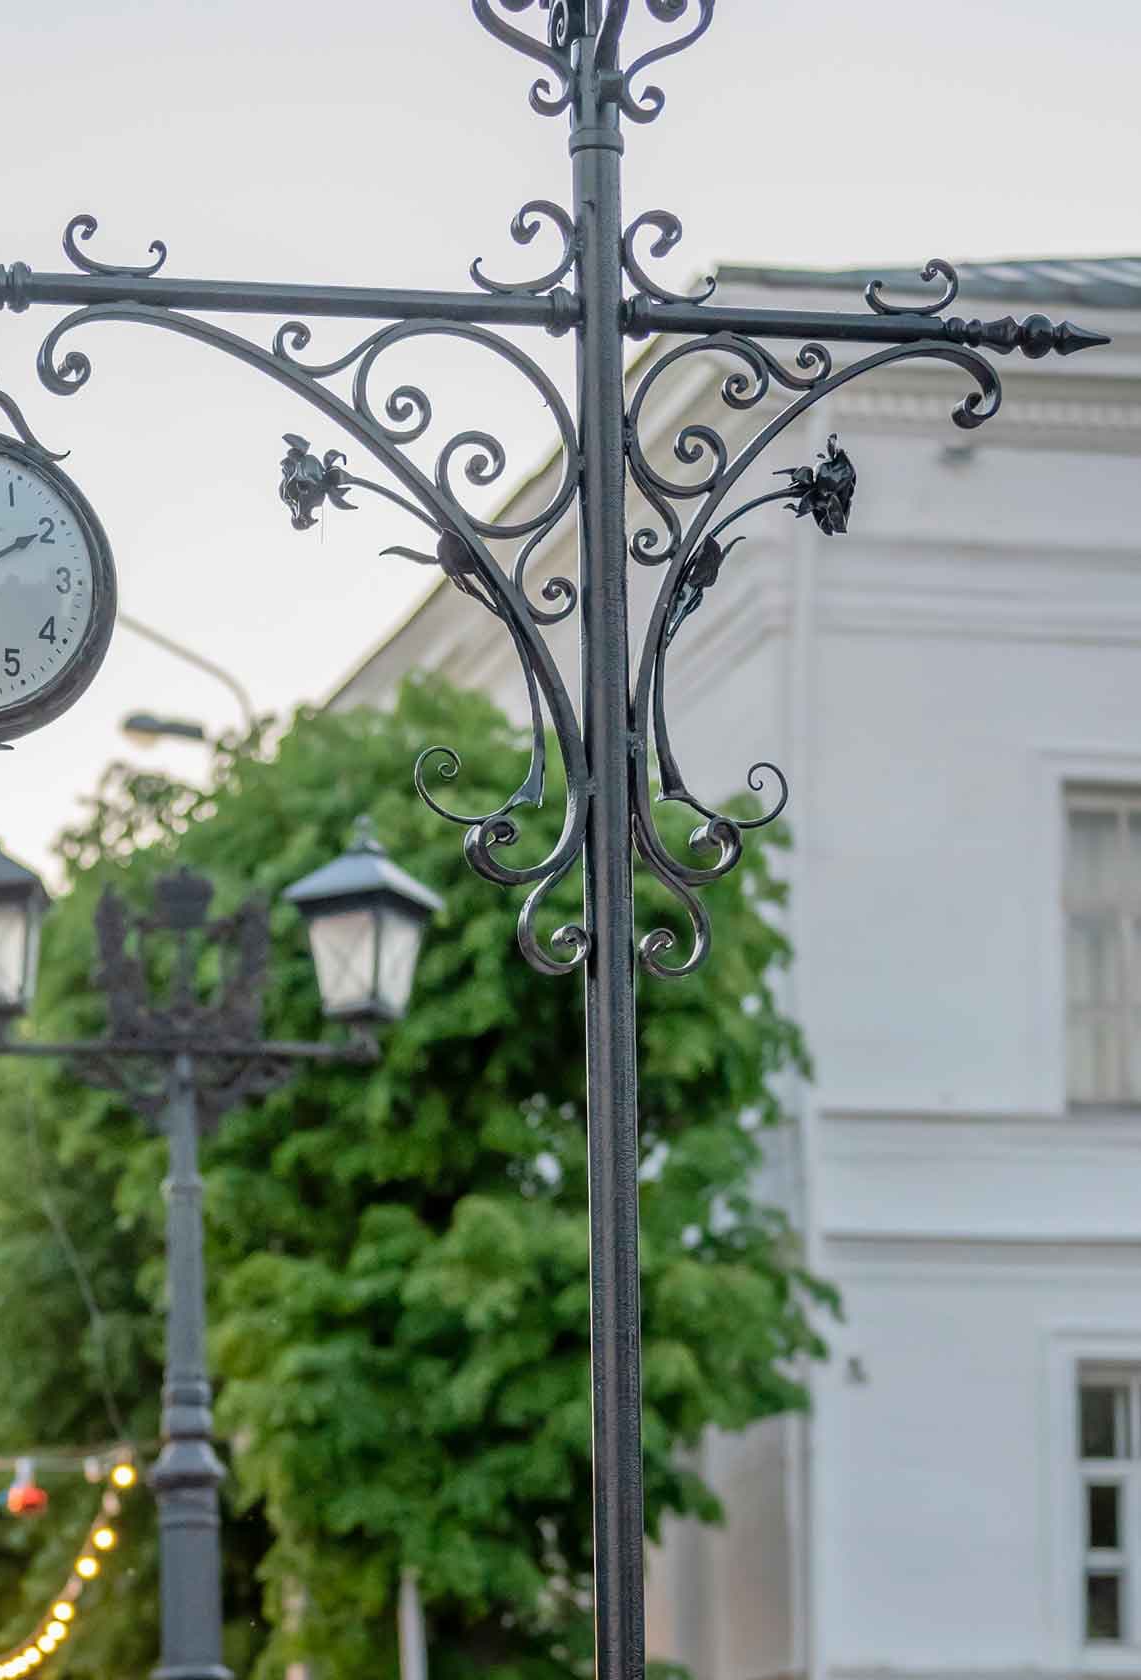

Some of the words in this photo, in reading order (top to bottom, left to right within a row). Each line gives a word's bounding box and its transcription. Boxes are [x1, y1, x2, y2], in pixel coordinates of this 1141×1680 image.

[8, 482, 15, 507] 1
[38, 517, 55, 544] 2
[56, 567, 71, 594] 3
[38, 616, 56, 644] 4
[4, 648, 20, 677] 5
